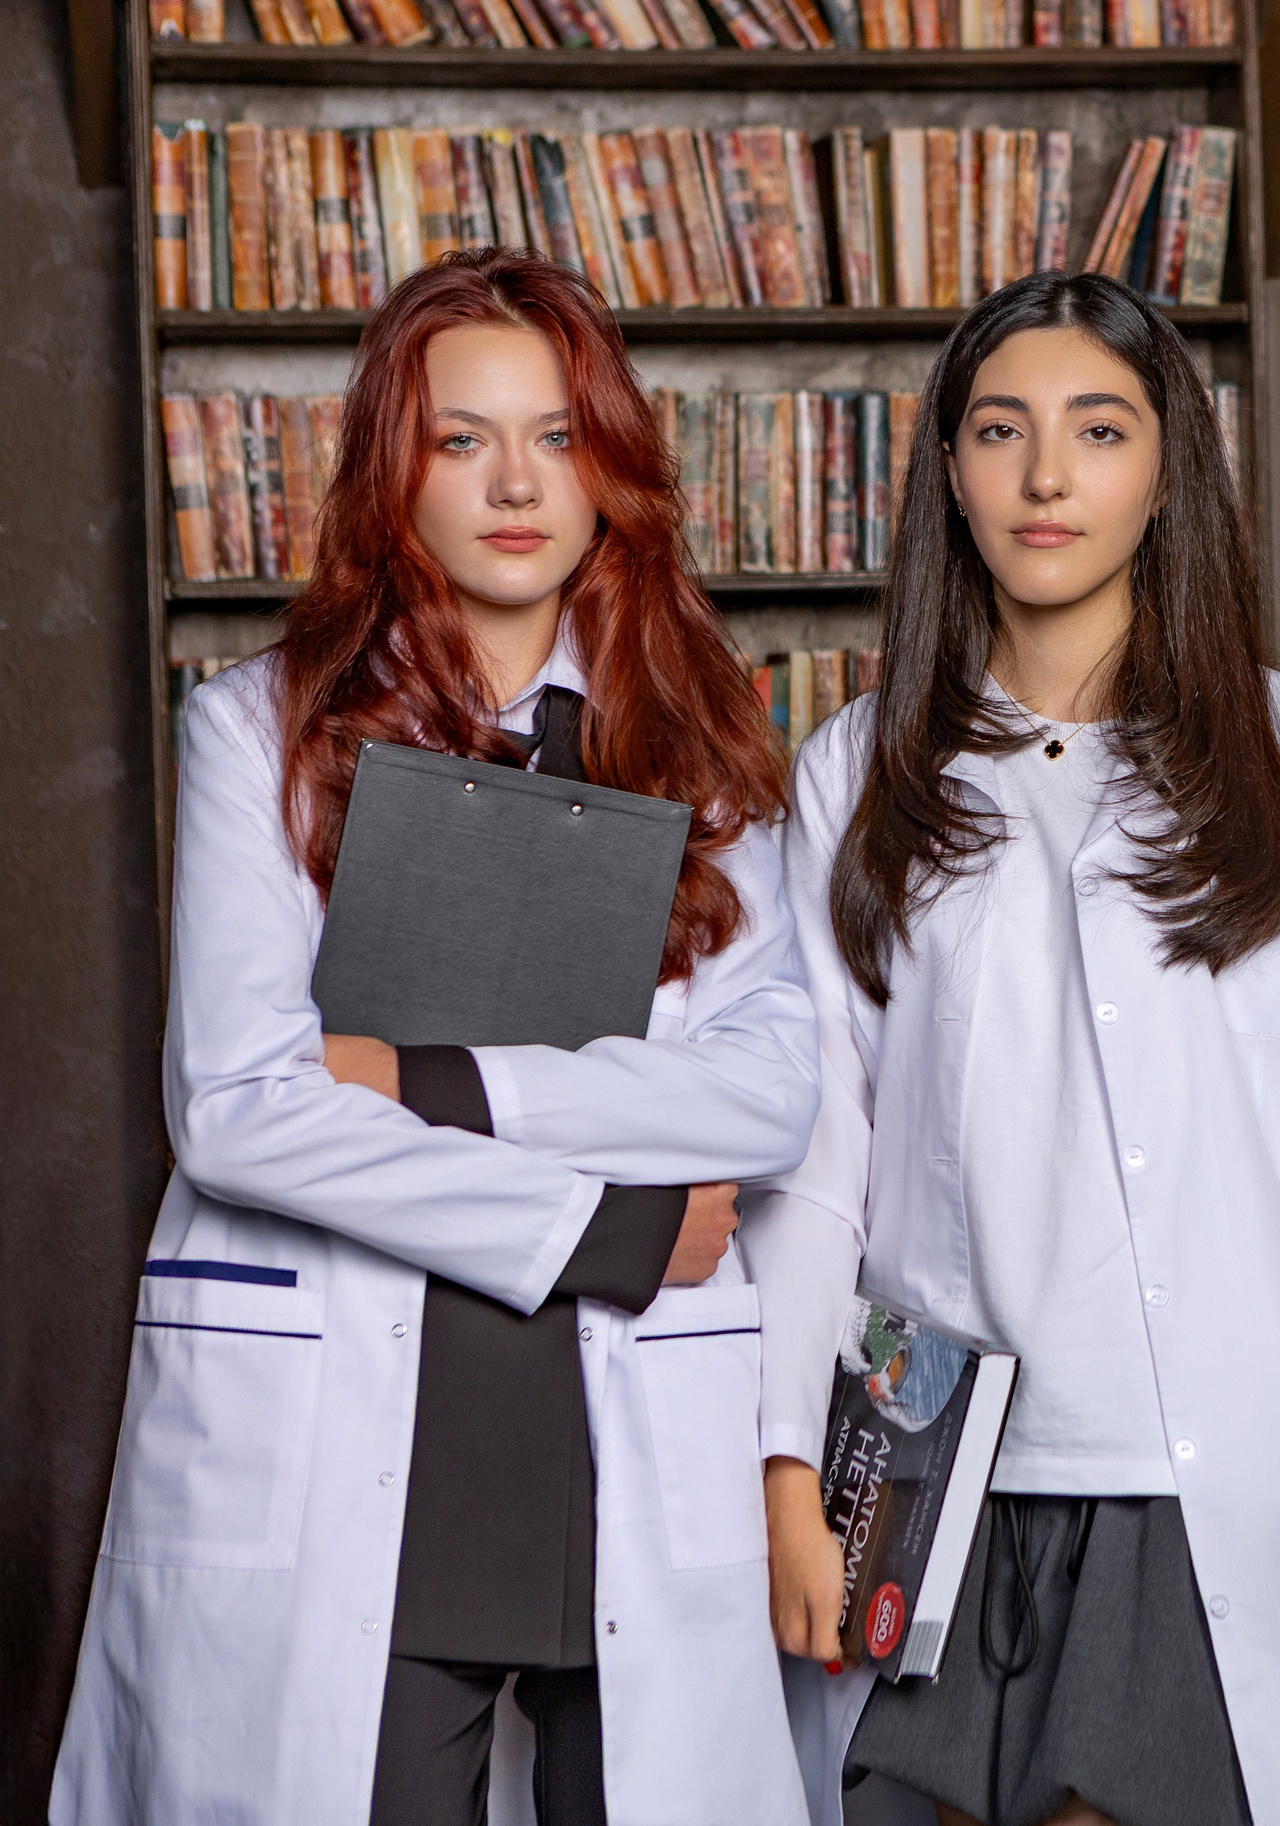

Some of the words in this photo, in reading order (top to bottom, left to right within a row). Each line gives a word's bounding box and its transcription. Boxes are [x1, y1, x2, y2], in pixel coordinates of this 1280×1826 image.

[934, 1411, 953, 1465] ДЖОН
[911, 1488, 934, 1556] ХАНСЕН
[877, 1599, 892, 1643] 600
